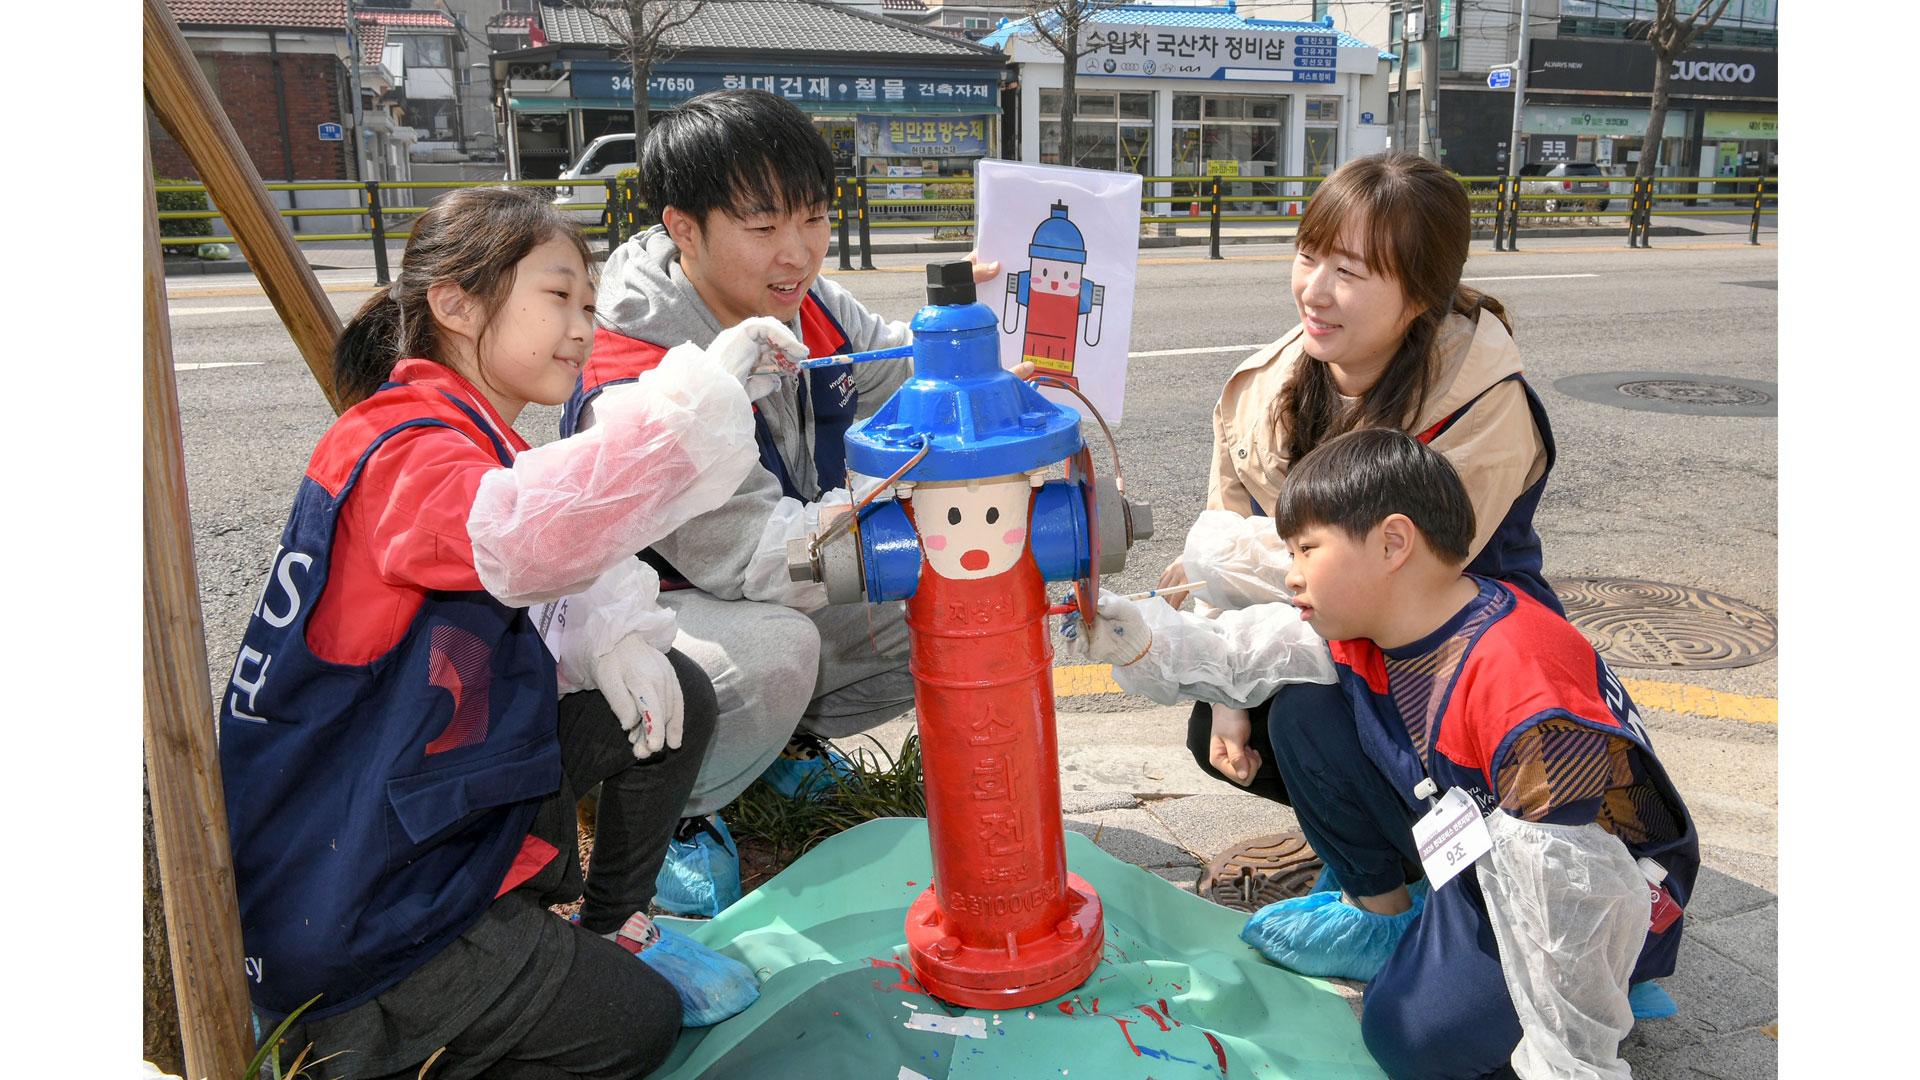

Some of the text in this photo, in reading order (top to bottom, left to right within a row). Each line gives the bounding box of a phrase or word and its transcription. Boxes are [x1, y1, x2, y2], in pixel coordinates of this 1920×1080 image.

[1086, 30, 1285, 61] 수입차 국산차 정비샵
[611, 76, 695, 92] 34-7650
[855, 78, 906, 99] 철물
[918, 83, 989, 98] 건축자재
[889, 120, 985, 144] 칠만표방수제
[1541, 140, 1567, 157] 쿠쿠
